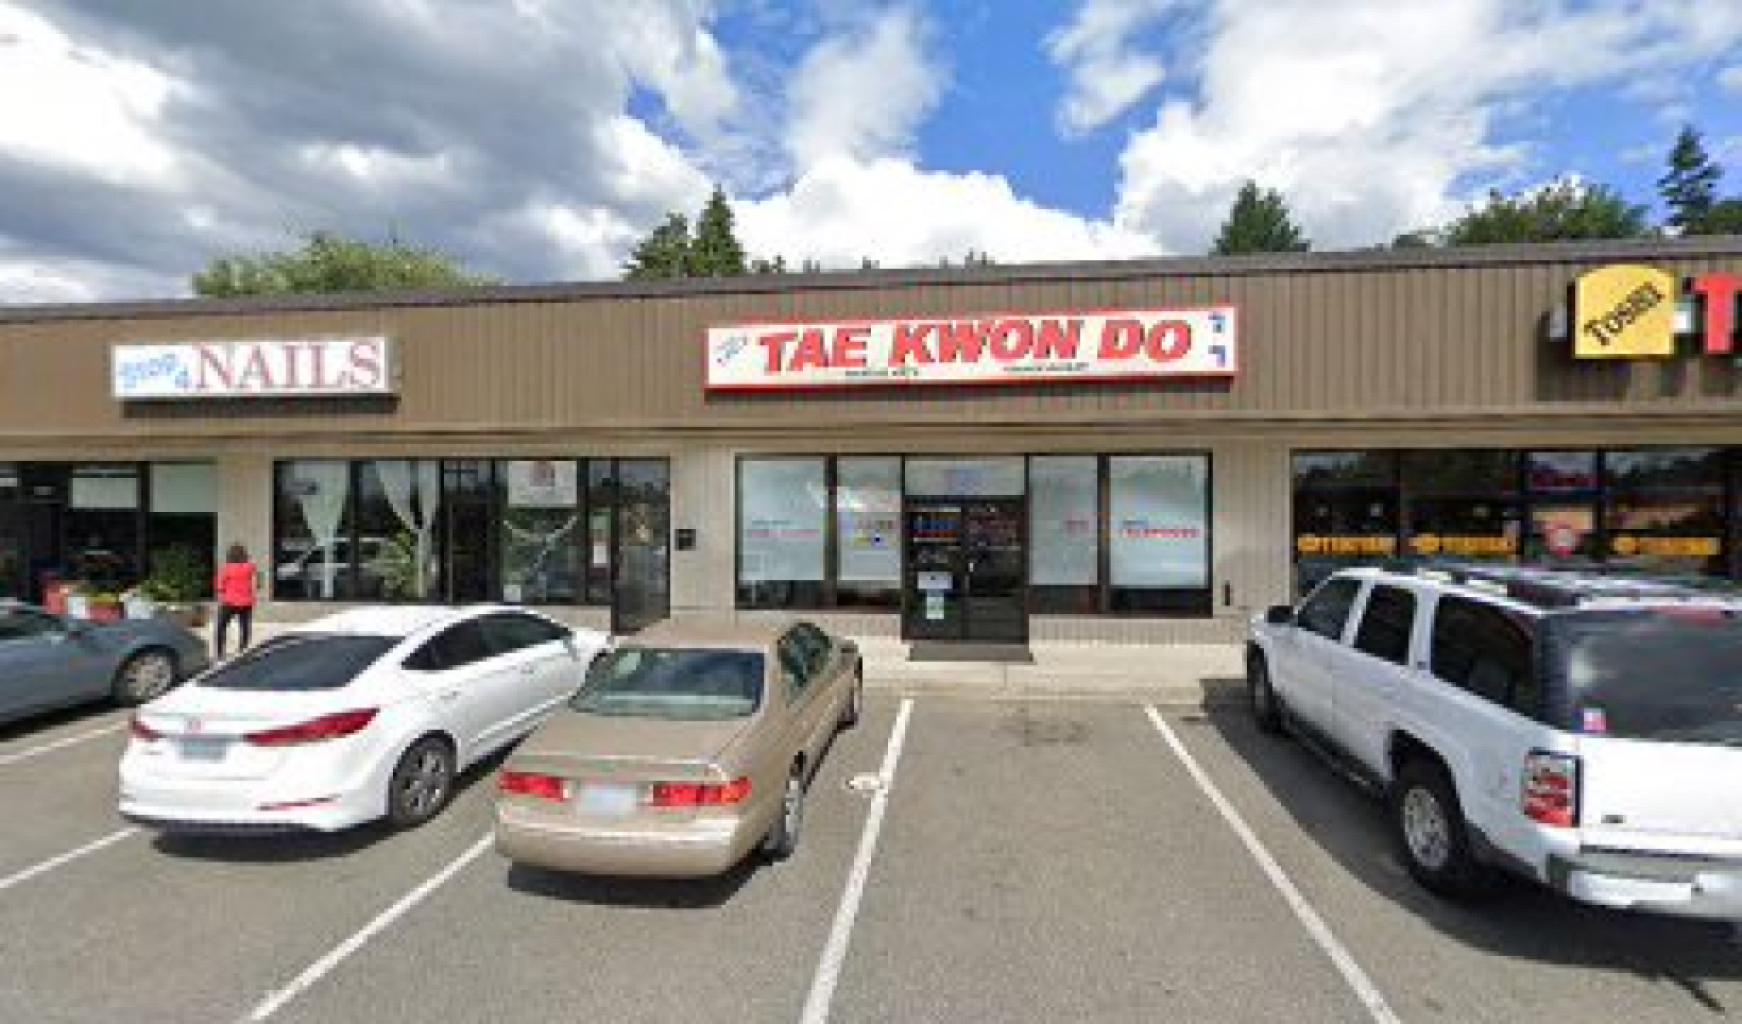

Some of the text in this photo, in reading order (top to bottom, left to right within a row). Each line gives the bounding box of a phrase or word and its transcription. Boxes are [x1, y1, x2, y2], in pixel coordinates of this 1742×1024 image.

[193, 341, 381, 390] NAILS
[759, 327, 872, 377] TAE
[888, 319, 1085, 364] KWON
[1097, 319, 1192, 363] DO
